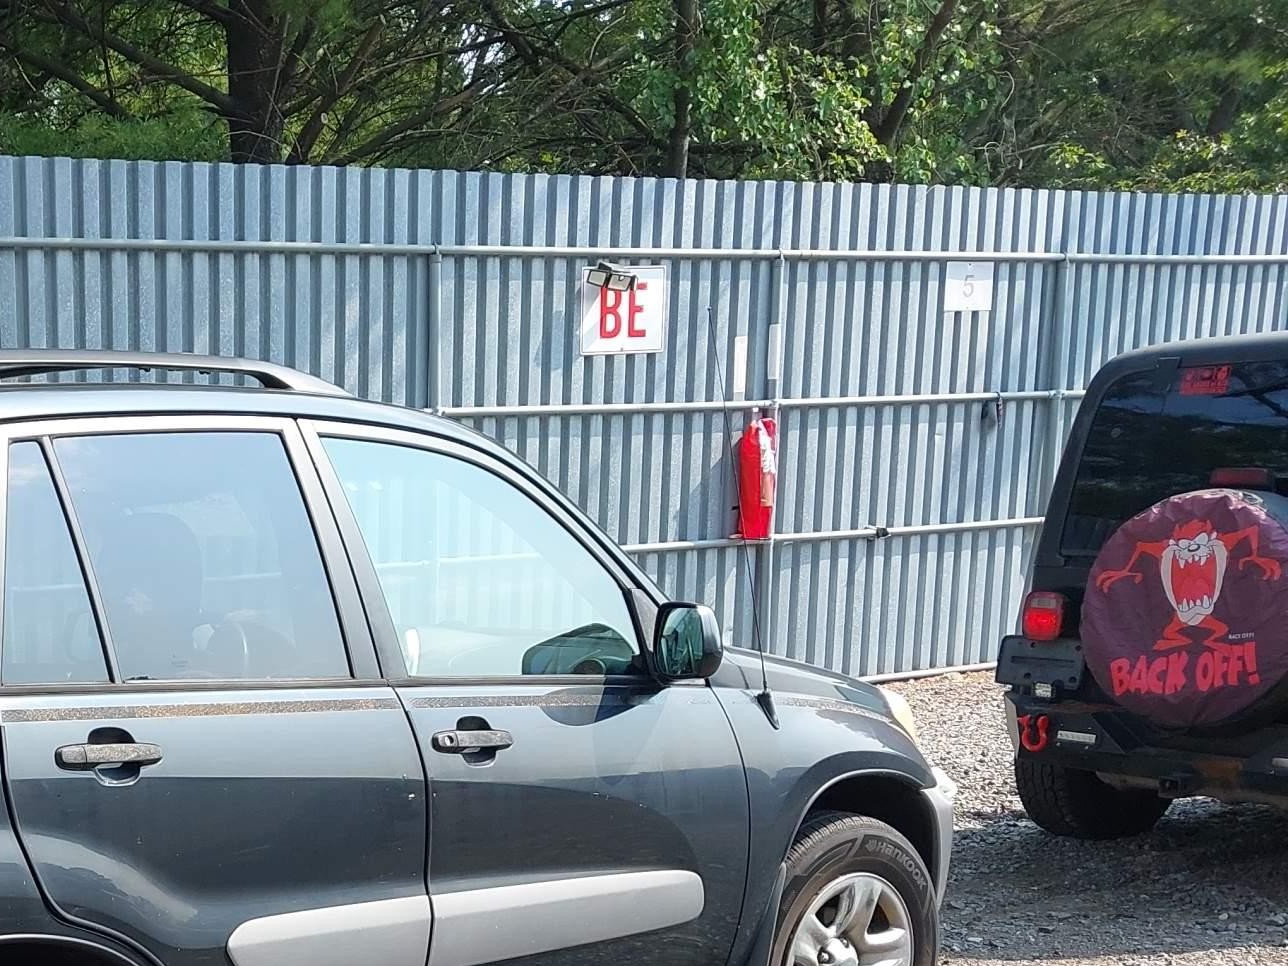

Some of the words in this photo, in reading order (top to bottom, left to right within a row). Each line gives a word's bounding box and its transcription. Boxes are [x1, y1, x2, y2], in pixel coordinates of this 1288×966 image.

[600, 282, 648, 339] BE
[962, 274, 975, 298] 5
[1110, 651, 1189, 697] BACK
[1196, 641, 1261, 692] OFF!
